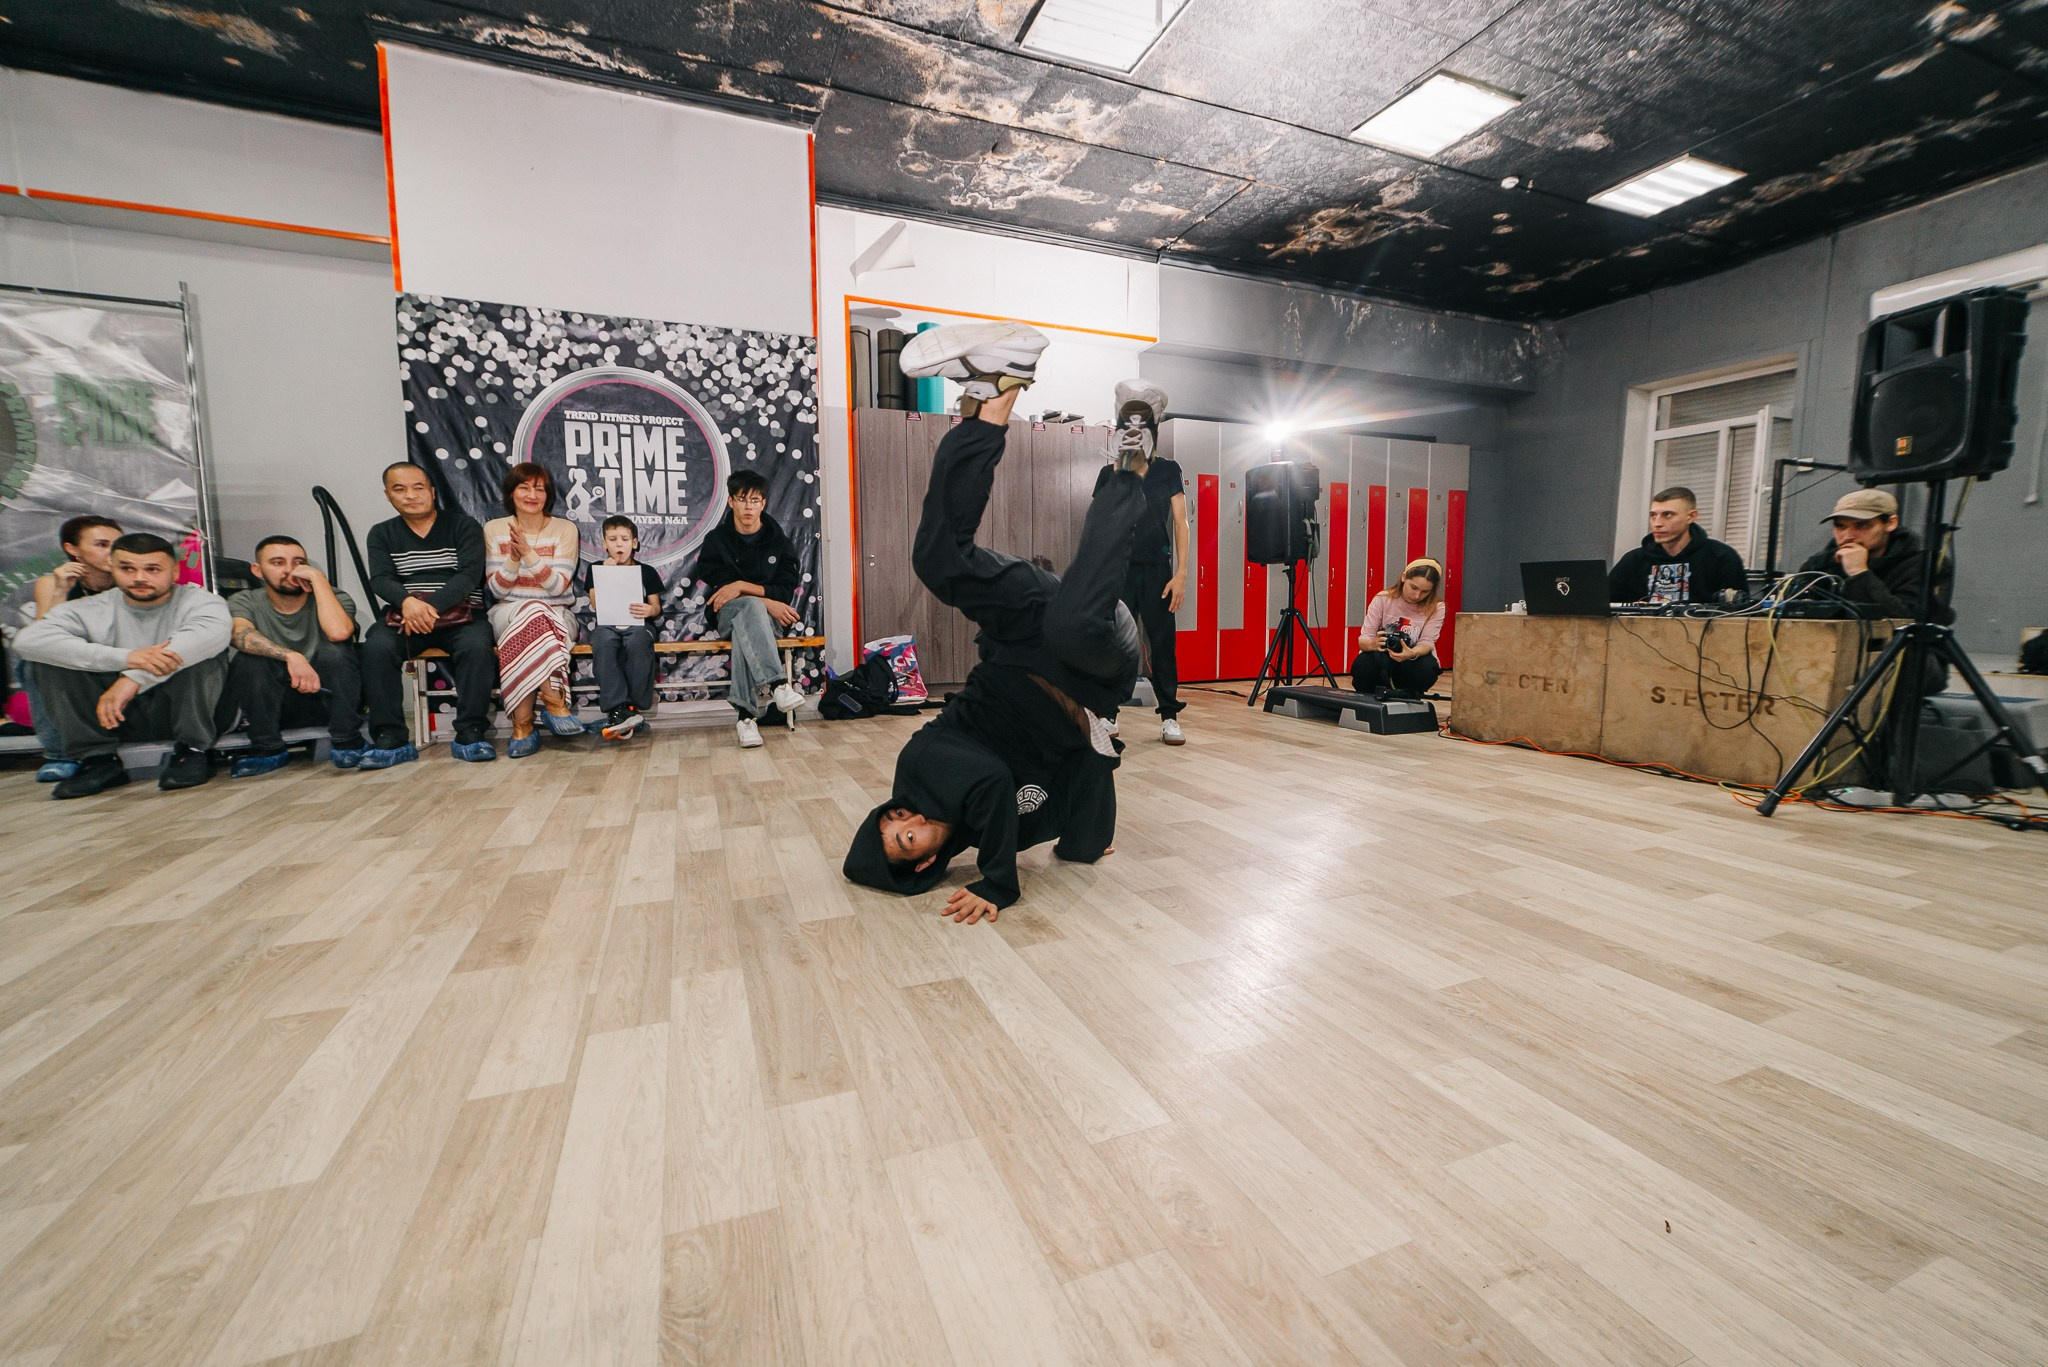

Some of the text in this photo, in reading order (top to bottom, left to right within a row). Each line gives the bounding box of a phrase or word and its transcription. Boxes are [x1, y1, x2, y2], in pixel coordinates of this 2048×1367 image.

[564, 410, 684, 426] TREND FITNESS PROJECT
[599, 469, 687, 514] TIME
[665, 515, 688, 524] N&A
